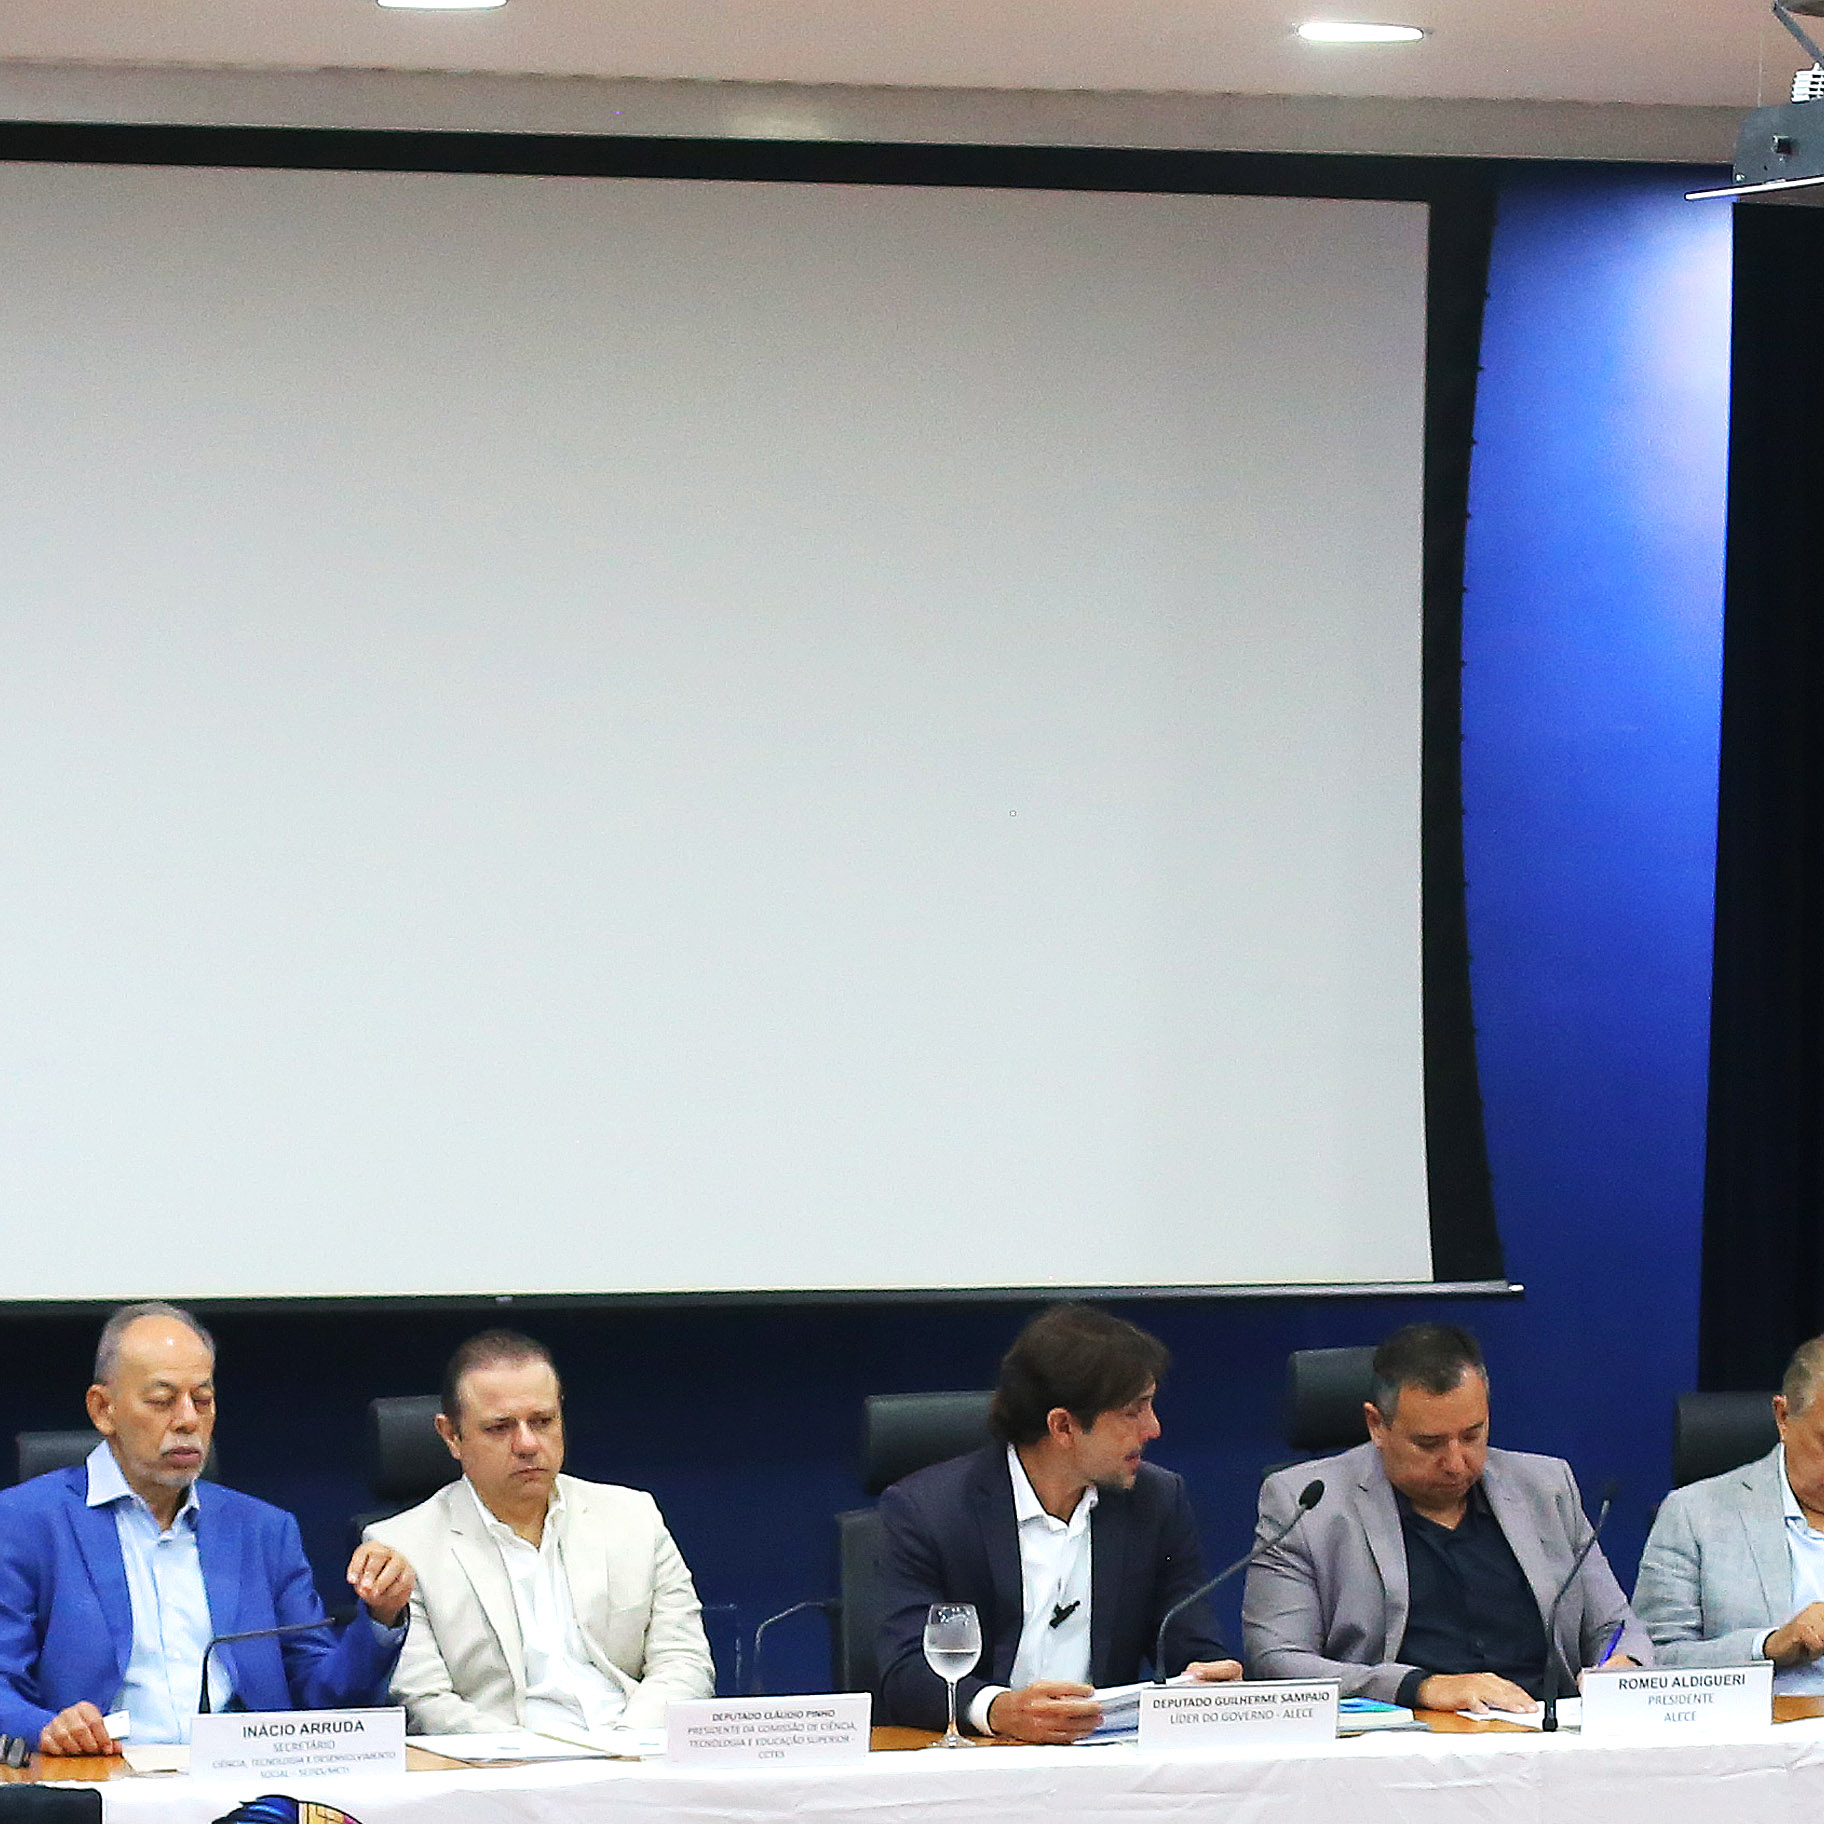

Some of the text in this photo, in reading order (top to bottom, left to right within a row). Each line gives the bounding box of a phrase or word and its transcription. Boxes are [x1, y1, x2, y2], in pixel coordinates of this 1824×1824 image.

[1618, 1674, 1746, 1690] ROMEU ALDIGUERI
[1153, 1691, 1330, 1709] DEPUTADO GUILHERME SAMPAIO
[1647, 1693, 1714, 1705] PRESIDENTE
[712, 1711, 762, 1722] DEPUTADO
[1202, 1712, 1218, 1722] DO
[1221, 1710, 1274, 1721] GOVERNO
[1283, 1707, 1313, 1719] ALECE
[299, 1719, 365, 1735] ARRUDA
